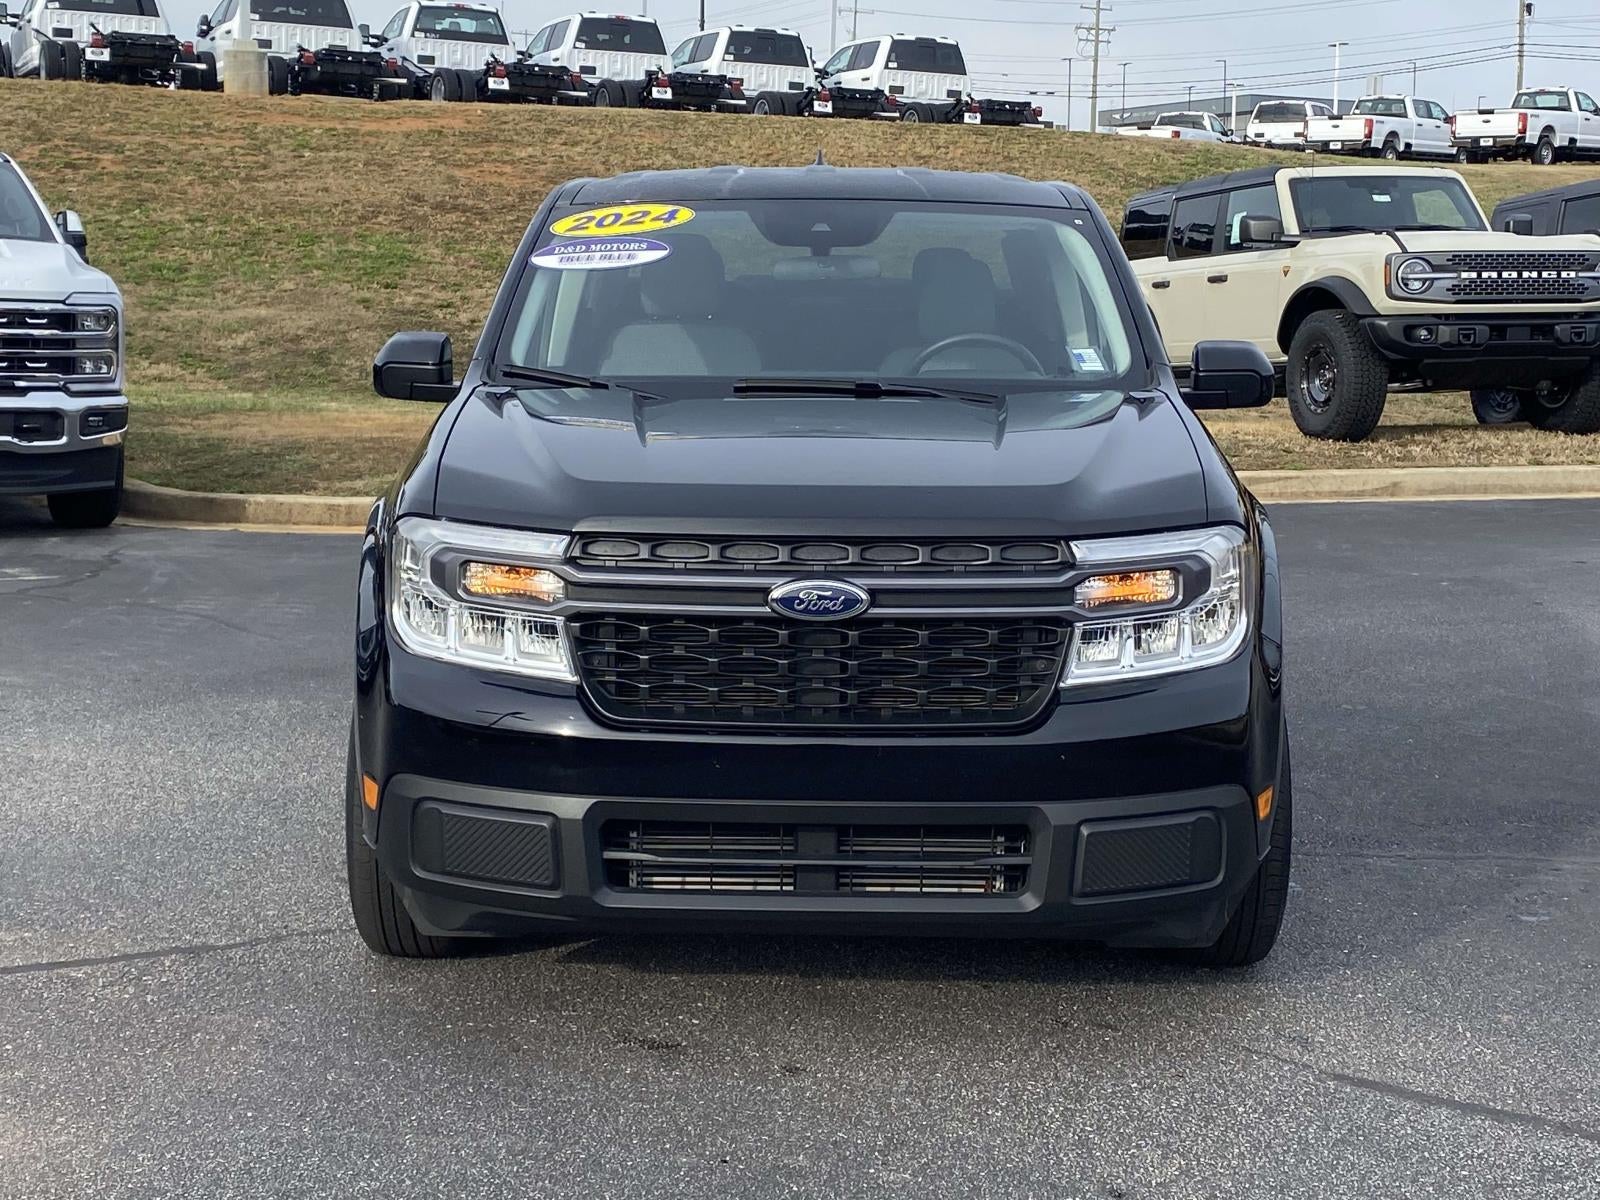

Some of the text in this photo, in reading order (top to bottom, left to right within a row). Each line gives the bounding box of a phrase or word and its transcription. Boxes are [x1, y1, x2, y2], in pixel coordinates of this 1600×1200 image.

[564, 208, 679, 232] 2024
[553, 242, 648, 254] D&D MOTORS
[599, 252, 636, 261] BLUE
[1460, 270, 1577, 279] BRONCO
[793, 589, 845, 611] Ford
